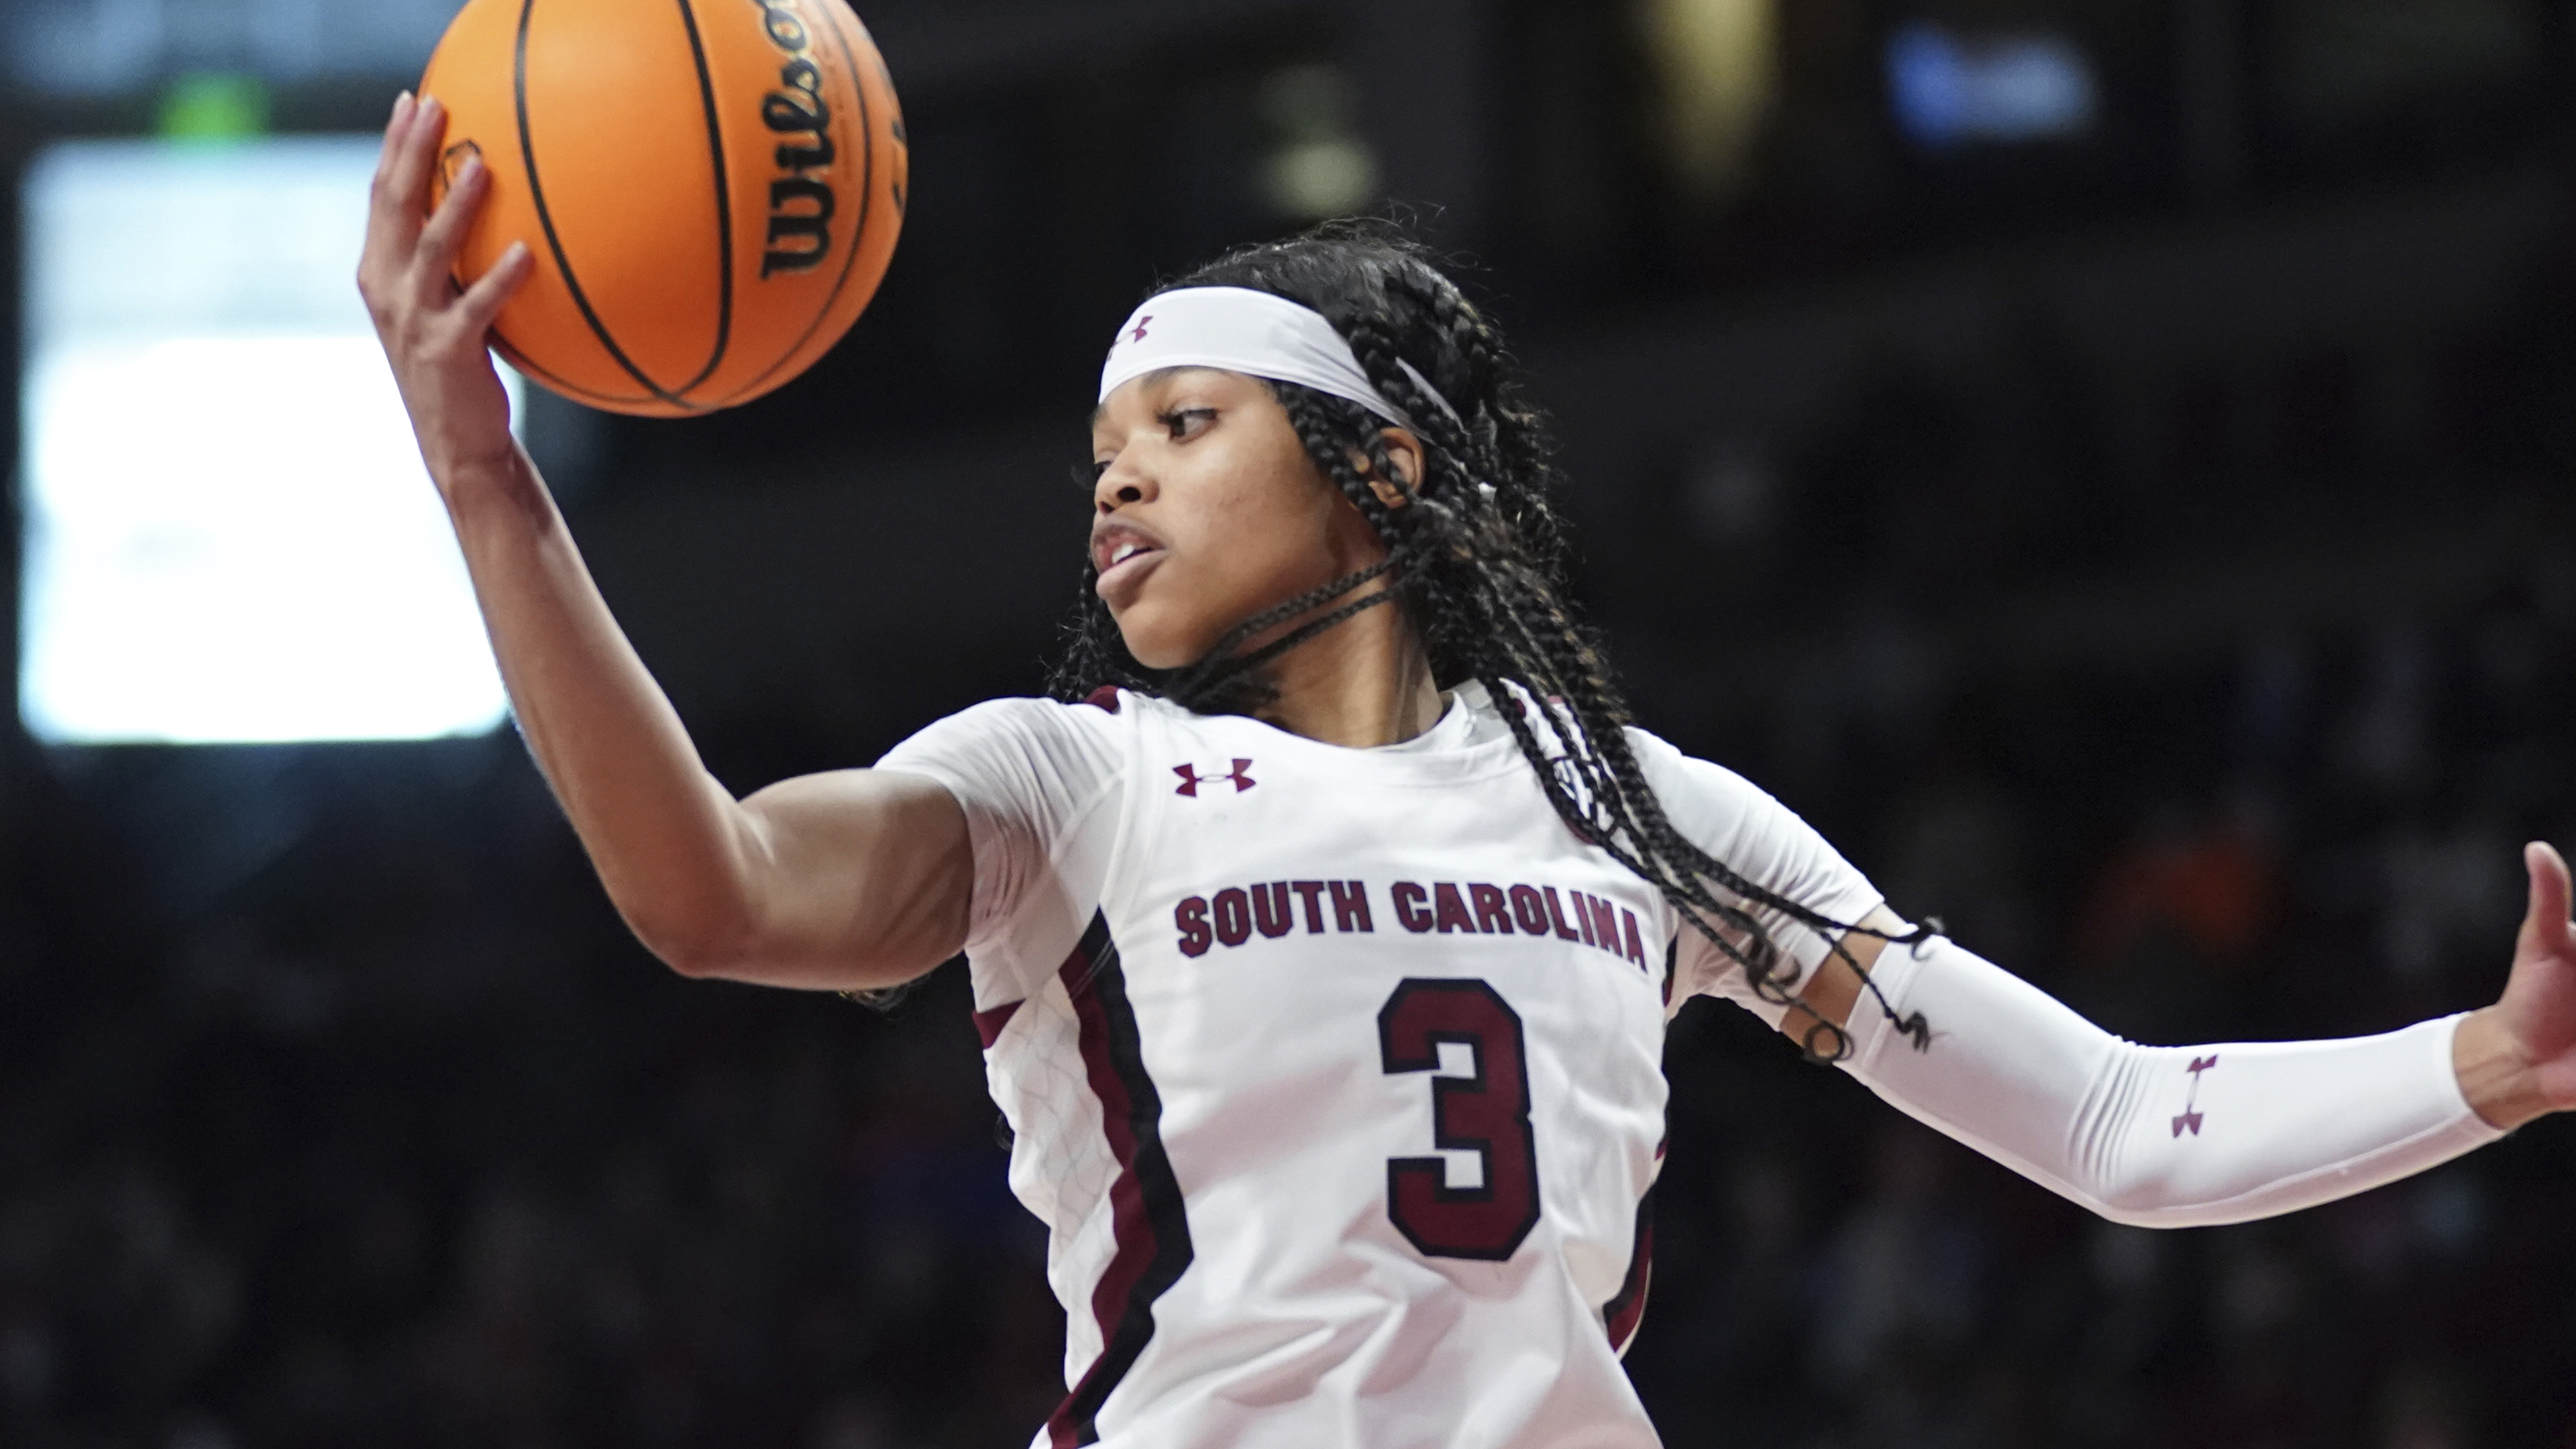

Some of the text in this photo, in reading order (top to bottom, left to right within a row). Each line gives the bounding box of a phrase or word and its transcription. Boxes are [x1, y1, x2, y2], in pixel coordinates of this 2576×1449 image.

[754, 0, 835, 280] Wilso
[1175, 880, 1648, 973] SOUTH CAROLINA
[1377, 977, 1541, 1262] 3
